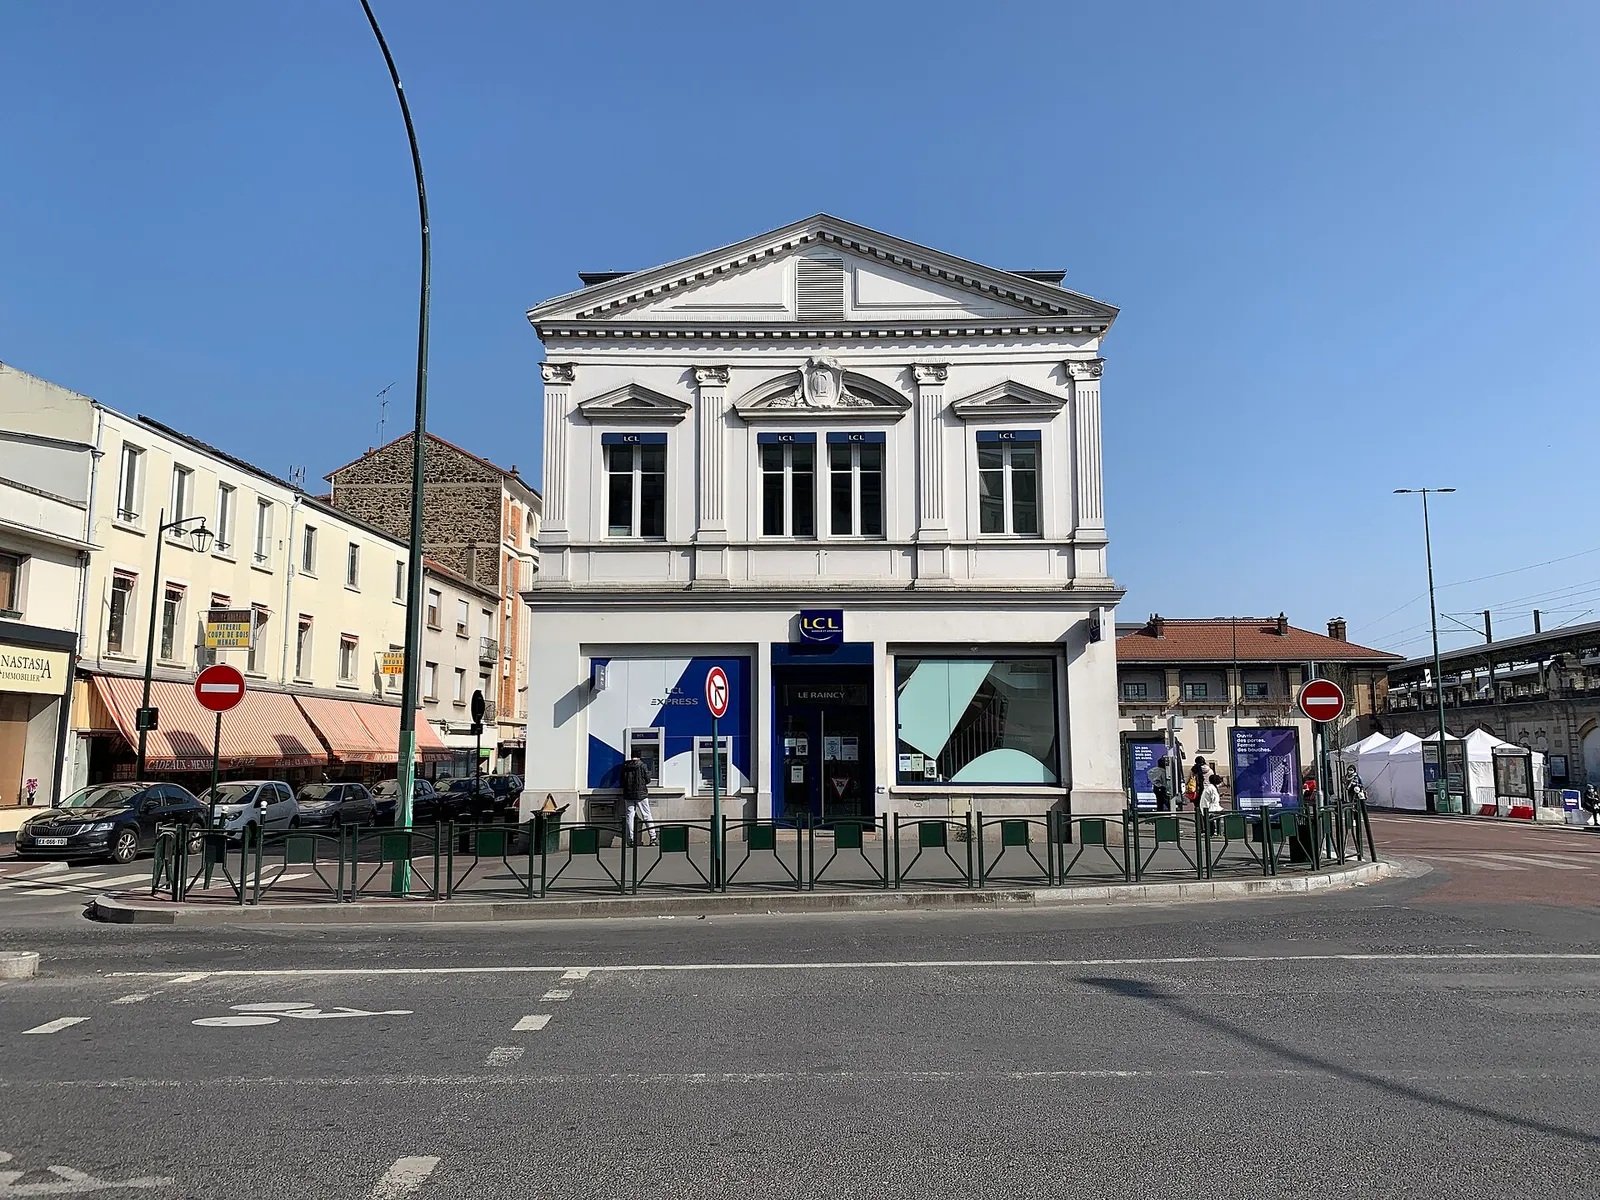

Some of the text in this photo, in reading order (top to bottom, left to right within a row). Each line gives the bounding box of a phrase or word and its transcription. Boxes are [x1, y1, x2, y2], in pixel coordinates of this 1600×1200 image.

[803, 617, 839, 629] LCL
[0, 654, 52, 679] NASTASIA
[2, 671, 40, 682] IMMOBILIER
[147, 760, 187, 770] CADEAUX
[191, 760, 214, 770] MENAG
